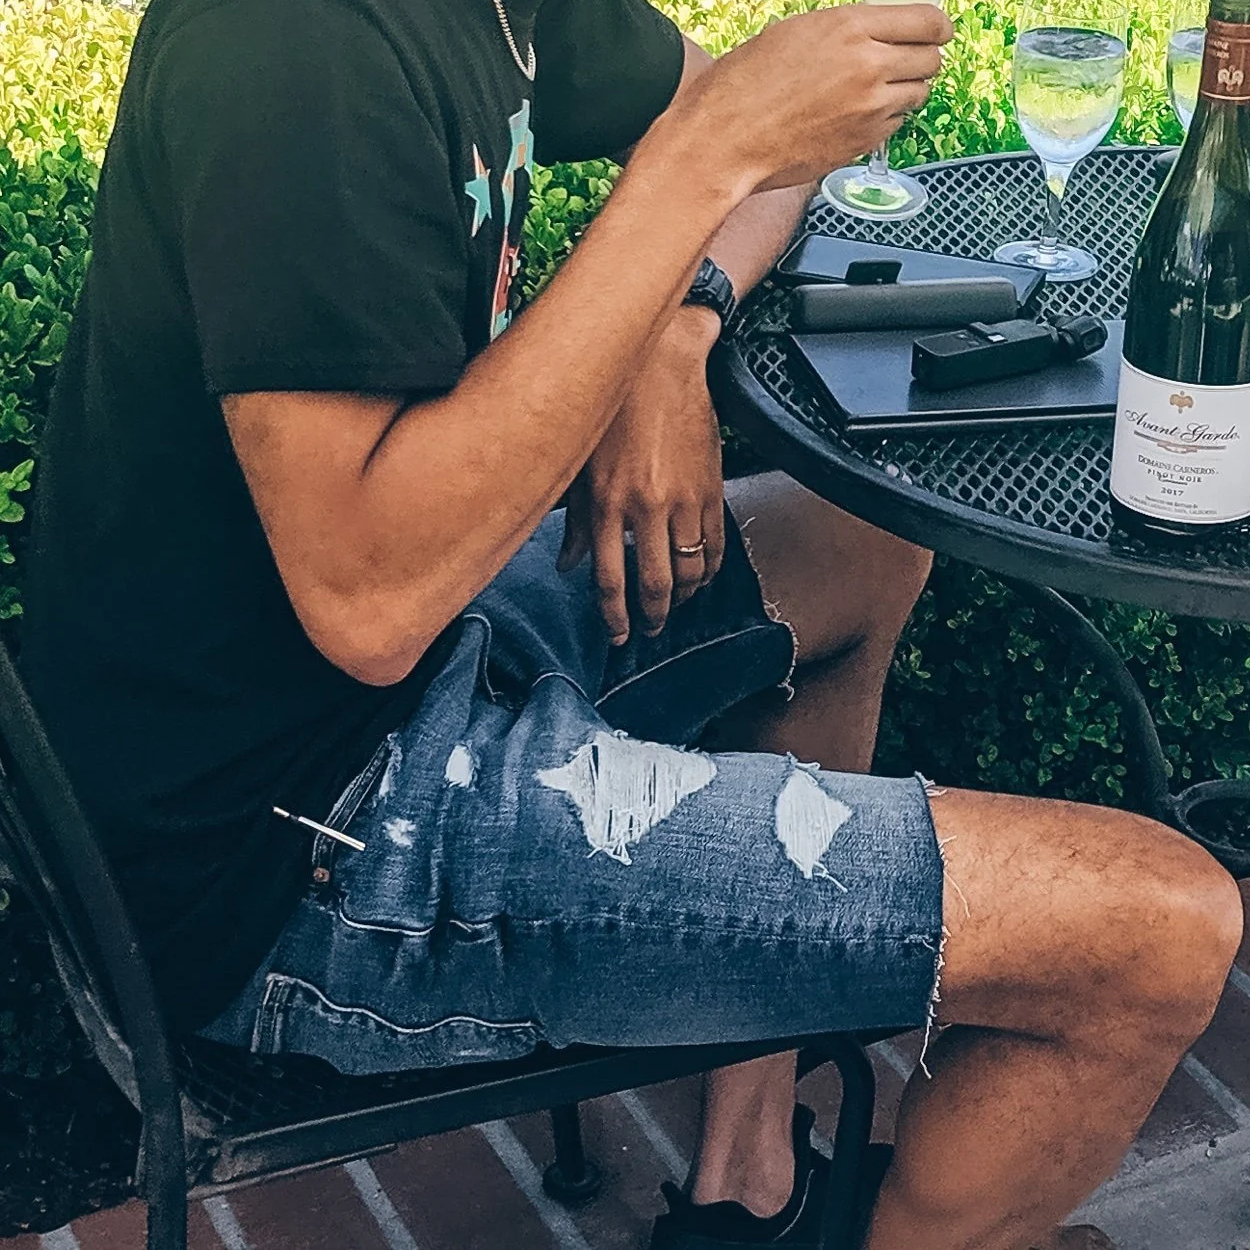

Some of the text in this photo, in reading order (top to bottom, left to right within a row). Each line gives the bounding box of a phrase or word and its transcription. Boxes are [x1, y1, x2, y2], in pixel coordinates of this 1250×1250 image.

[1125, 409, 1241, 443] Avant Garde
[1138, 454, 1172, 471] DOMAINE
[1146, 468, 1203, 483] PINOT NOIR
[1160, 487, 1185, 497] 2017
